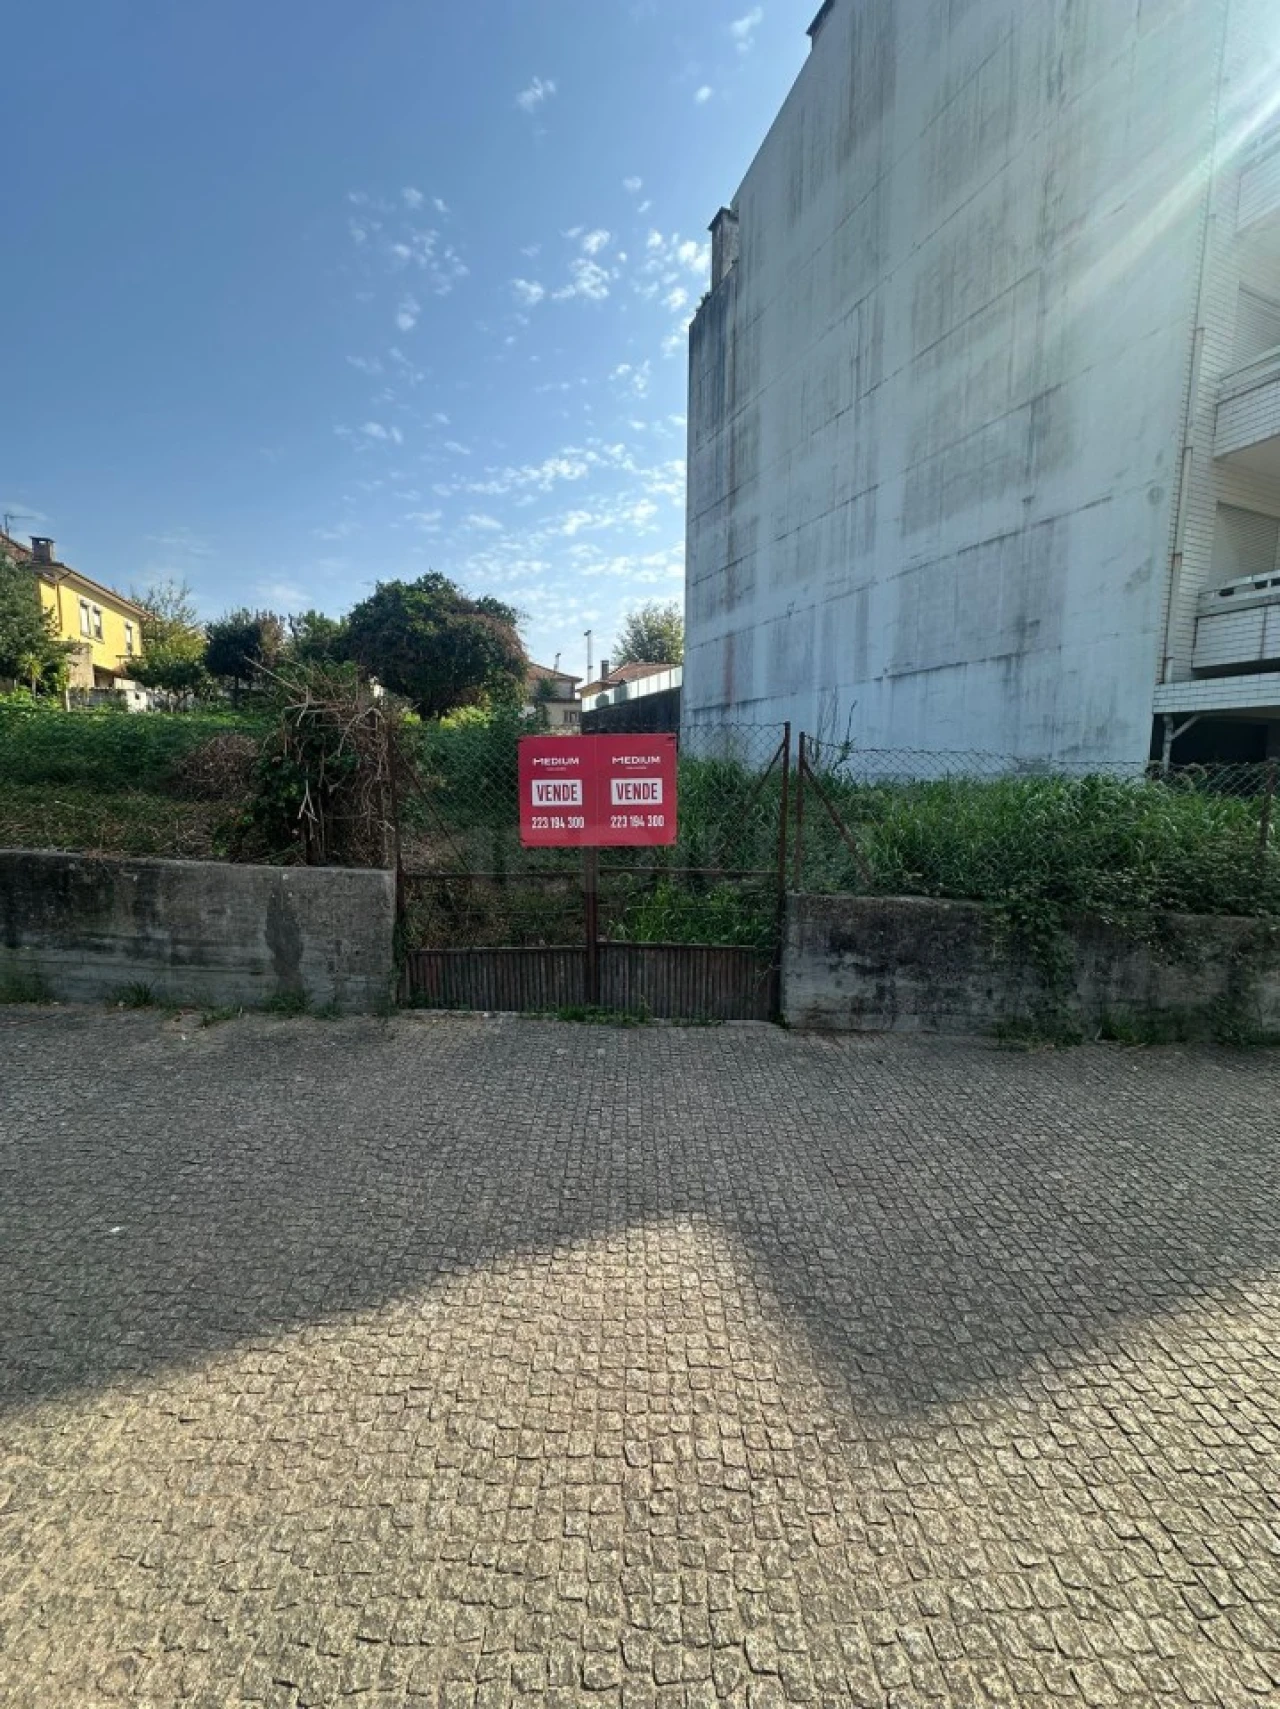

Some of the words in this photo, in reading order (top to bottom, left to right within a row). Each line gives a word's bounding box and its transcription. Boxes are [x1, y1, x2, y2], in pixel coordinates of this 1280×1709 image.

[533, 757, 580, 766] MEDIUM
[612, 756, 661, 765] MEDIUM
[536, 784, 578, 802] VENDE
[615, 782, 658, 800] VENDE
[531, 816, 548, 829] 223
[551, 816, 565, 829] 194
[567, 816, 585, 829] 300
[610, 815, 627, 828] 223
